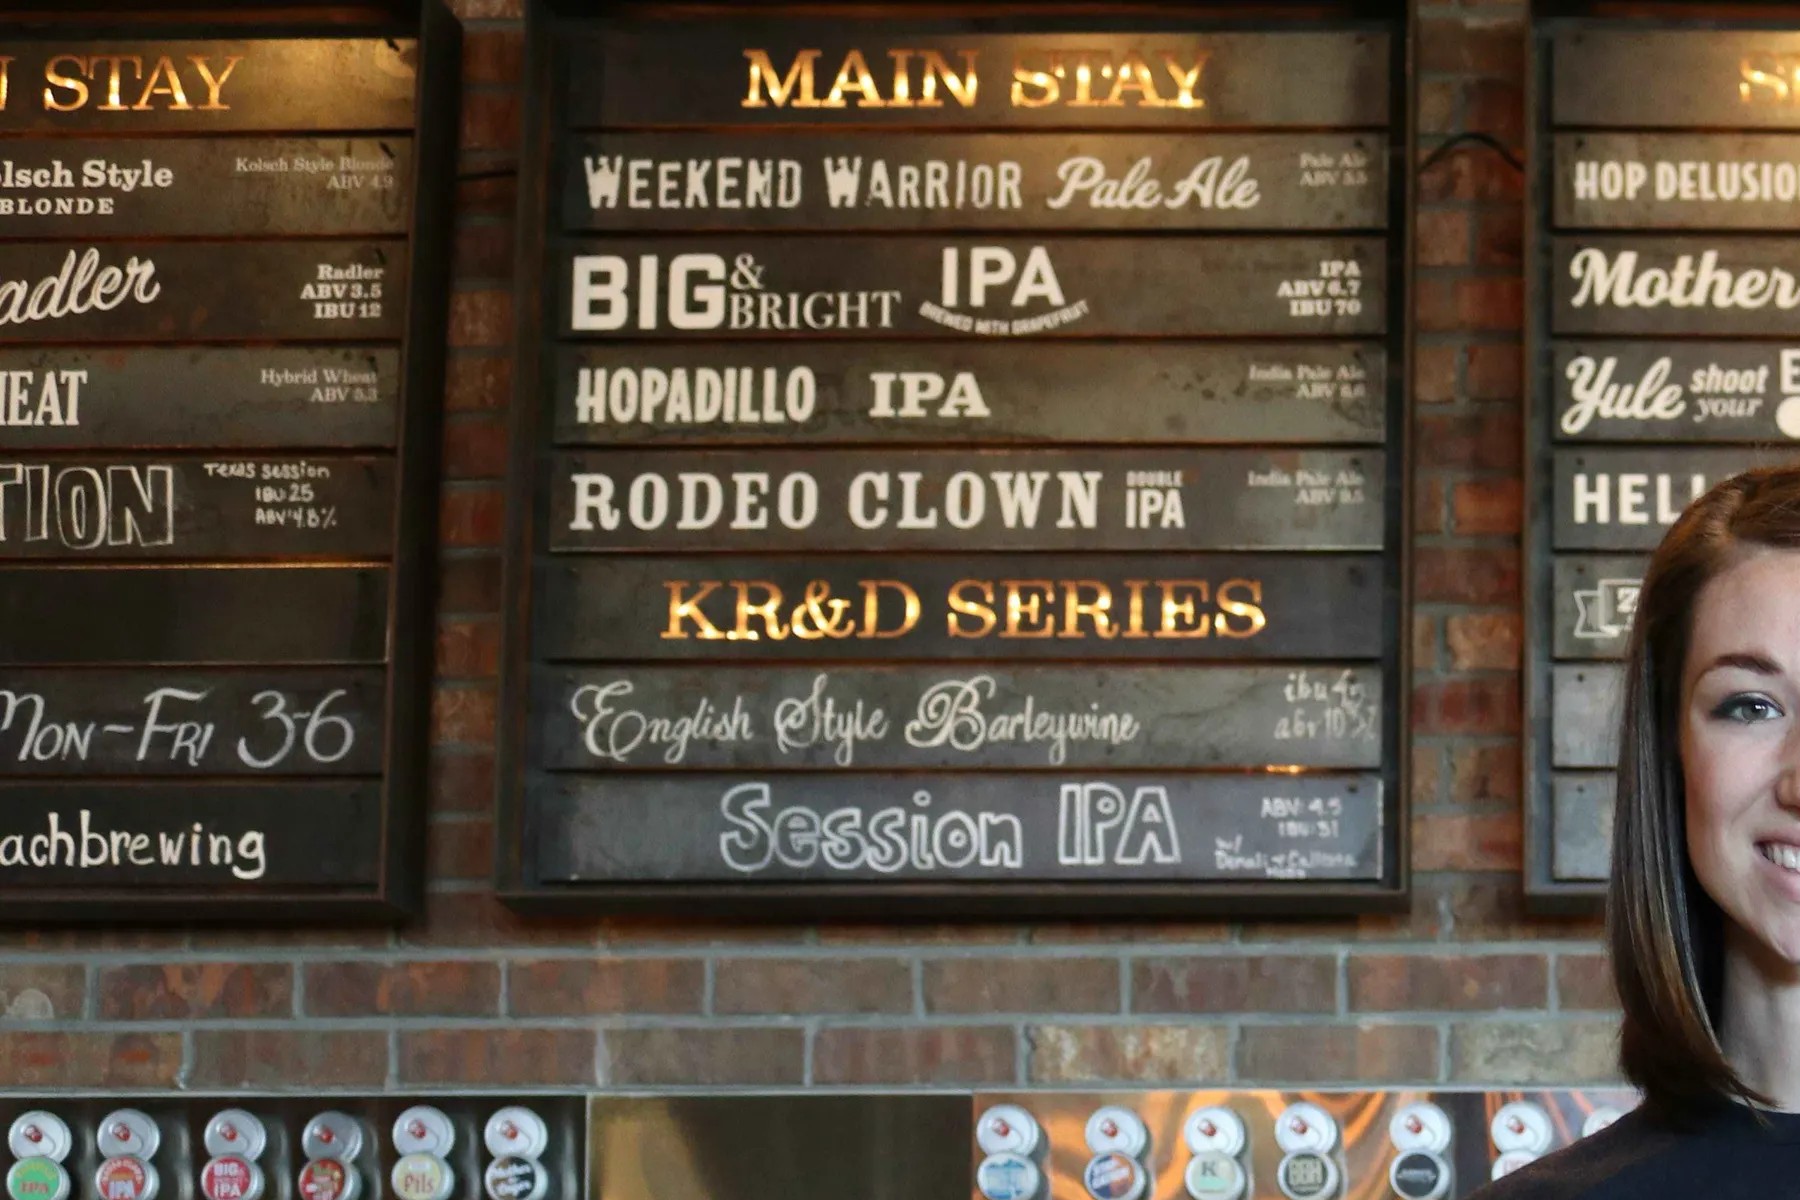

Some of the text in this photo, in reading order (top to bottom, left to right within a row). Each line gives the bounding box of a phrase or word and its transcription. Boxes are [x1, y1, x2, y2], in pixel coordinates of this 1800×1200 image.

[44, 54, 244, 111] STAY
[741, 48, 1212, 108] MAIN STAY
[0, 159, 174, 192] lsch Style
[235, 157, 289, 172] Kolsch
[584, 155, 1262, 210] WEEKEND WARRIOR Pale Ale
[1574, 160, 1650, 201] HOP
[317, 264, 384, 280] Radler
[941, 245, 1066, 308] IPA
[1319, 260, 1362, 277] IPA
[300, 283, 382, 299] ABV 3.5
[571, 252, 766, 330] BIG &
[1277, 280, 1325, 297] ABV
[314, 302, 381, 319] IBU 12
[729, 291, 902, 330] BRIGHT
[260, 369, 377, 387] Hybrid Wheat
[310, 388, 349, 402] ABV
[576, 365, 992, 424] HOPADILLO IPA
[1561, 356, 1686, 434] Yule
[1689, 364, 1769, 394] shoot
[1693, 398, 1762, 423] your
[1126, 470, 1185, 487] DOUBLE
[568, 471, 1103, 531] RODEO CLOWN
[1125, 488, 1186, 529] IPA
[660, 578, 1268, 641] KR&D SERIES
[571, 673, 1140, 767] English Style Barleywine
[719, 781, 1182, 873] Session IPA
[404, 1173, 435, 1195] Pils
